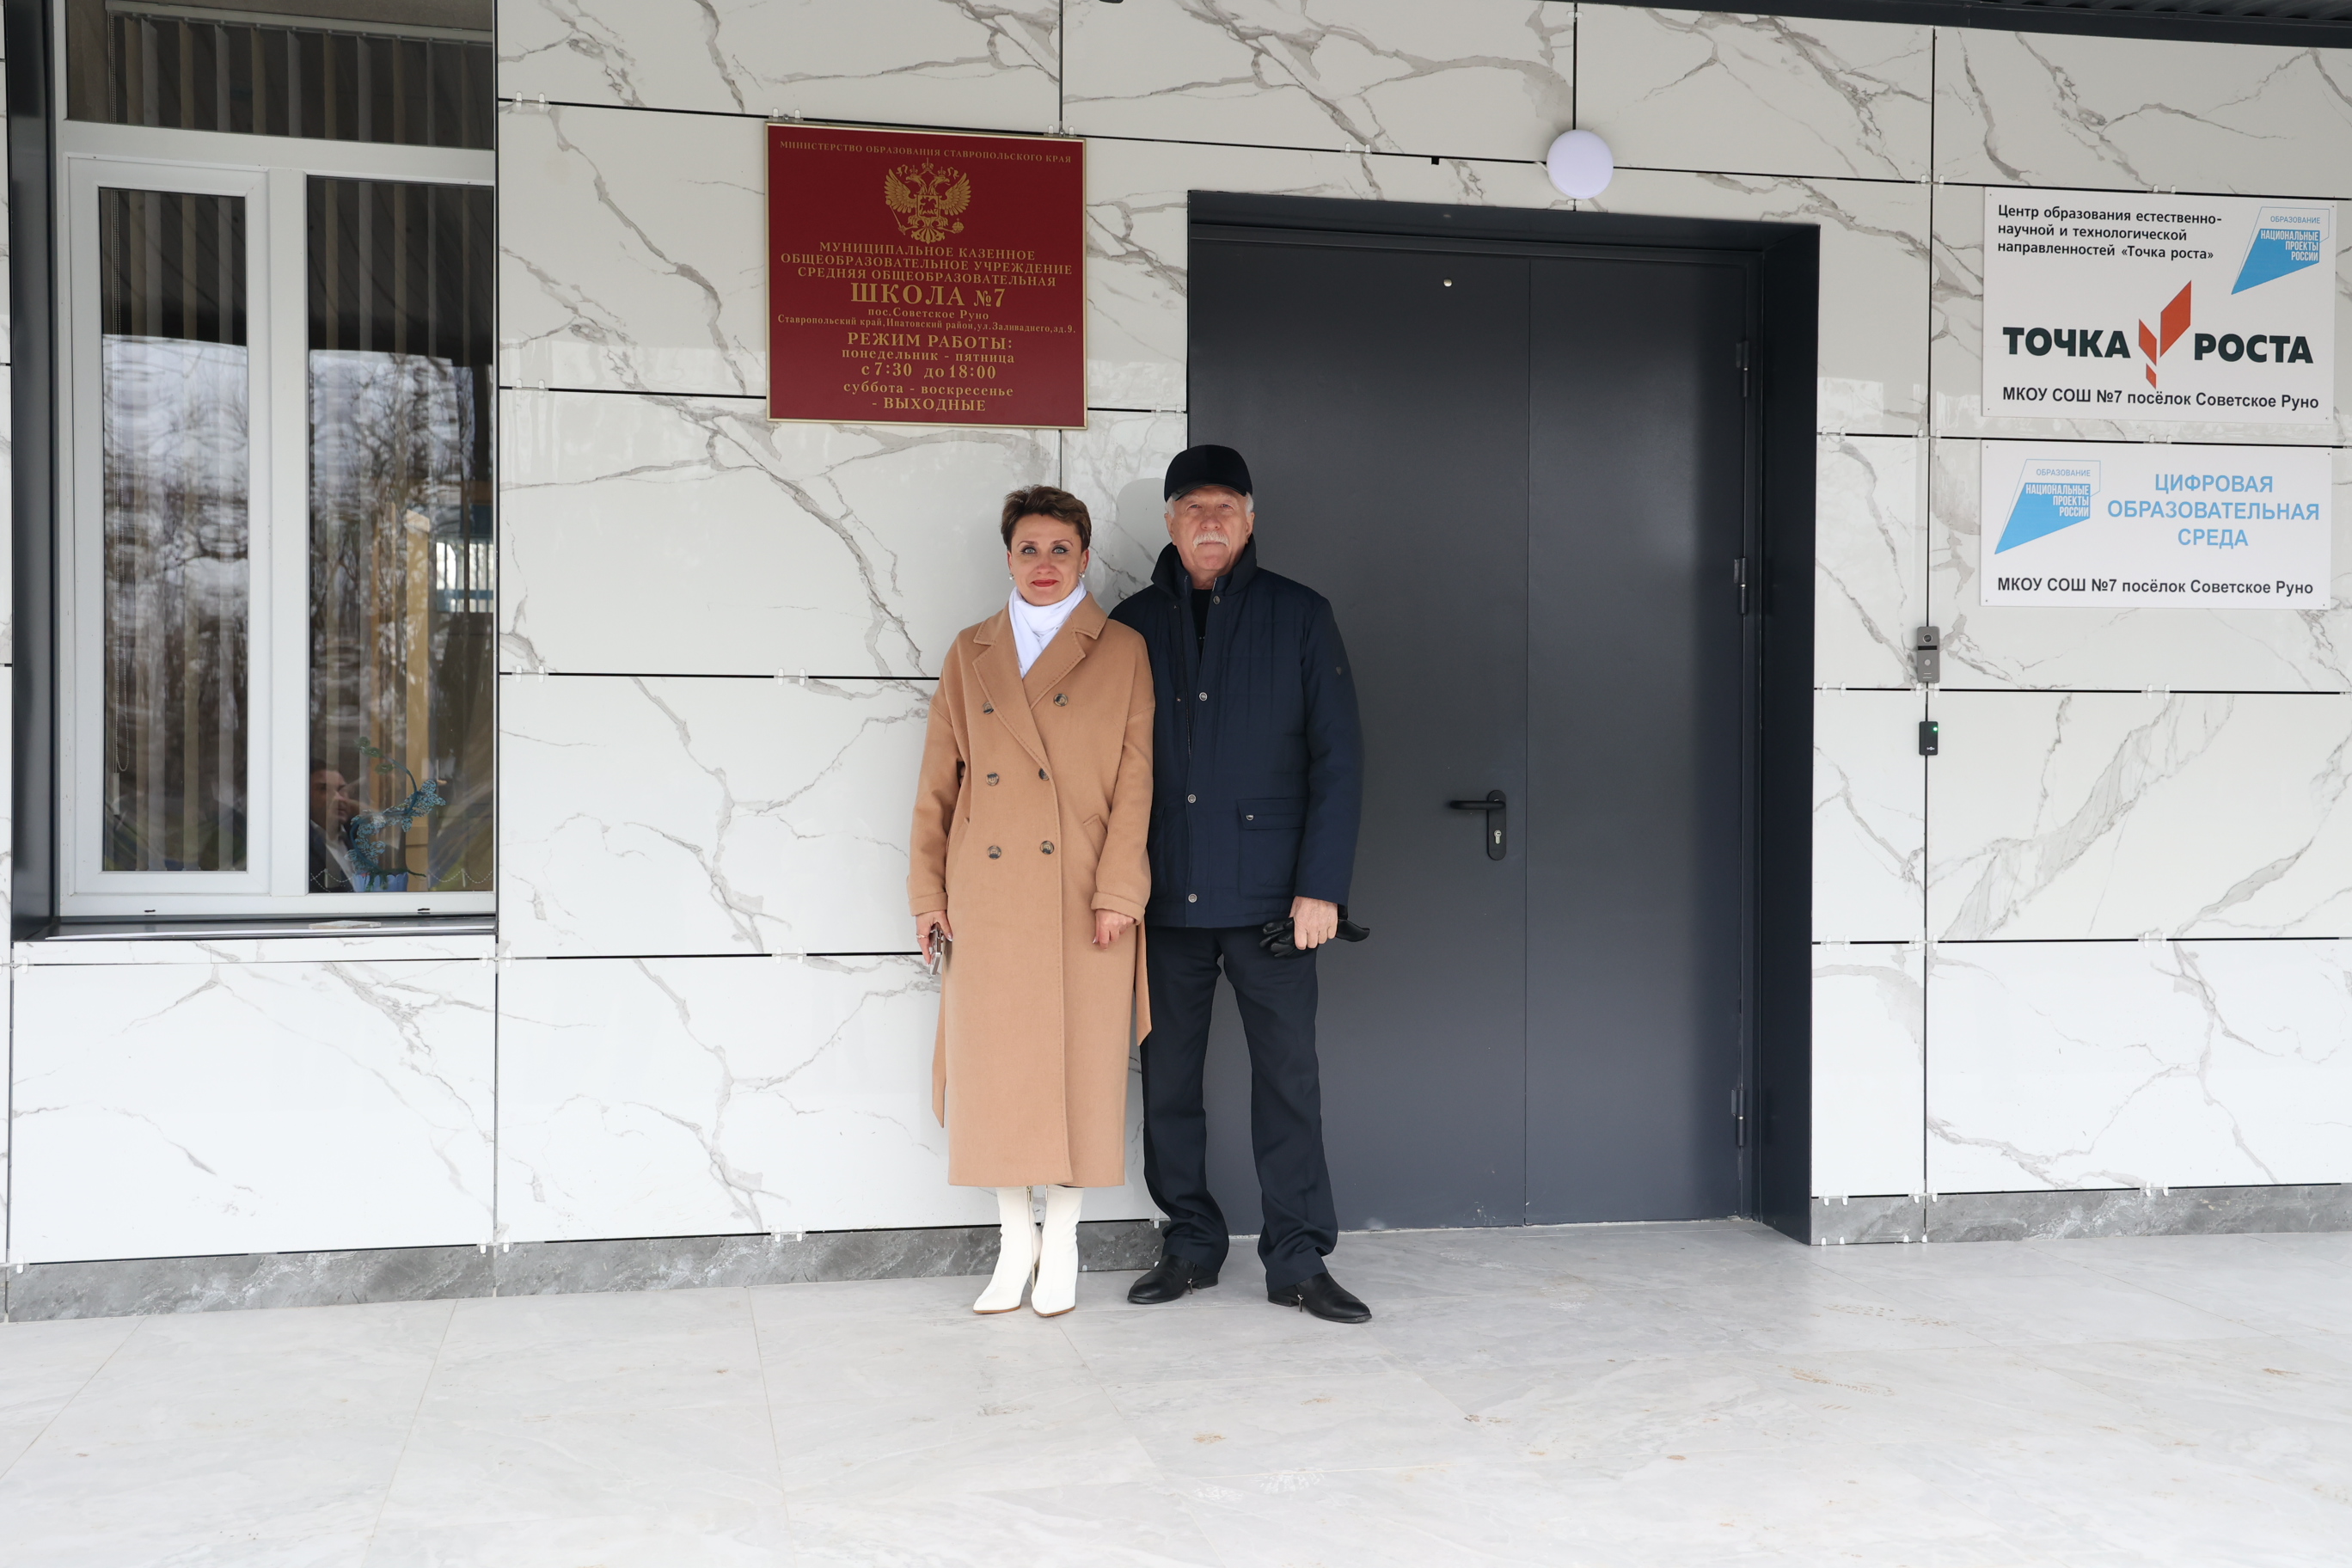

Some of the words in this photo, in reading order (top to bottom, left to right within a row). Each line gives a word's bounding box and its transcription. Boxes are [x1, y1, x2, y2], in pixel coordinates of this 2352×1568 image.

[780, 140, 863, 152] МИНИСТЕРСТВО
[866, 145, 940, 156] ОБРАЗОВАНИЯ
[943, 150, 1043, 162] СТАВРОПОЛЬСКОГО
[1045, 155, 1071, 163] КРАЯ
[1998, 204, 2039, 221] Центр
[2043, 205, 2131, 222] образования
[2135, 212, 2222, 224] естественно-
[2269, 215, 2321, 224] ОБРАЗОВАНИЕ
[1998, 224, 2055, 238] научной
[2060, 227, 2067, 236] и
[2072, 228, 2187, 241] технологической
[2259, 229, 2320, 243] НАЦИОНАЛЬНЫЕ
[818, 241, 953, 259] МУНИЦИПАЛЬНОЕ
[959, 248, 1035, 260] КАЗЕННОЕ
[1998, 242, 2116, 256] направленностей
[2121, 245, 2165, 258] «Точка
[2171, 249, 2214, 261] роста»
[2284, 240, 2319, 253] ПРОЕКТЫ
[781, 251, 969, 272] ОБЩЕОБРАЗОВАТЕЛЬНОЕ
[973, 260, 1072, 276] УЧРЕЖДЕНИЕ
[2290, 250, 2319, 262] РОССИИ
[798, 266, 867, 279] СРЕДНЯЯ
[870, 268, 1057, 288] ОБЩЕОБРАЗОВАТЕЛЬНАЯ
[850, 281, 966, 306] ШКОЛА
[777, 314, 857, 326] Ставропольский
[959, 309, 989, 322] Руно
[847, 332, 921, 347] РЕЖИМ
[928, 334, 1012, 350] РАБОТЫ:
[2002, 326, 2131, 358] ТОЧКА
[2194, 333, 2314, 364] РОСТА
[842, 349, 939, 361] понедельник
[955, 353, 1014, 364] пятница
[843, 380, 903, 395] суббота
[921, 386, 1014, 398] воскресенье
[884, 397, 986, 413] ВЫХОДНЫЕ
[2003, 386, 2048, 401] МКОУ
[2052, 388, 2092, 402] СОШ
[2128, 390, 2191, 406] посёлок
[2196, 392, 2276, 407] Советское
[2282, 394, 2319, 412] Руно
[2036, 469, 2092, 477] ОБРАЗОВАНИЕ
[2024, 483, 2091, 498] НАЦИОНАЛЬНЫЕ
[2155, 474, 2273, 494] ЦИФРОВАЯ
[2052, 494, 2090, 507] ПРОЕКТЫ
[2058, 505, 2090, 518] РОССИИ
[2107, 499, 2319, 521] ОБРАЗОВАТЕЛЬНАЯ
[2177, 528, 2249, 549] СРЕДА
[1998, 577, 2043, 591] МКОУ
[2047, 578, 2086, 591] СОШ
[2122, 579, 2186, 593] посёлок
[2190, 579, 2271, 594] Советское
[2275, 580, 2313, 597] Руно
